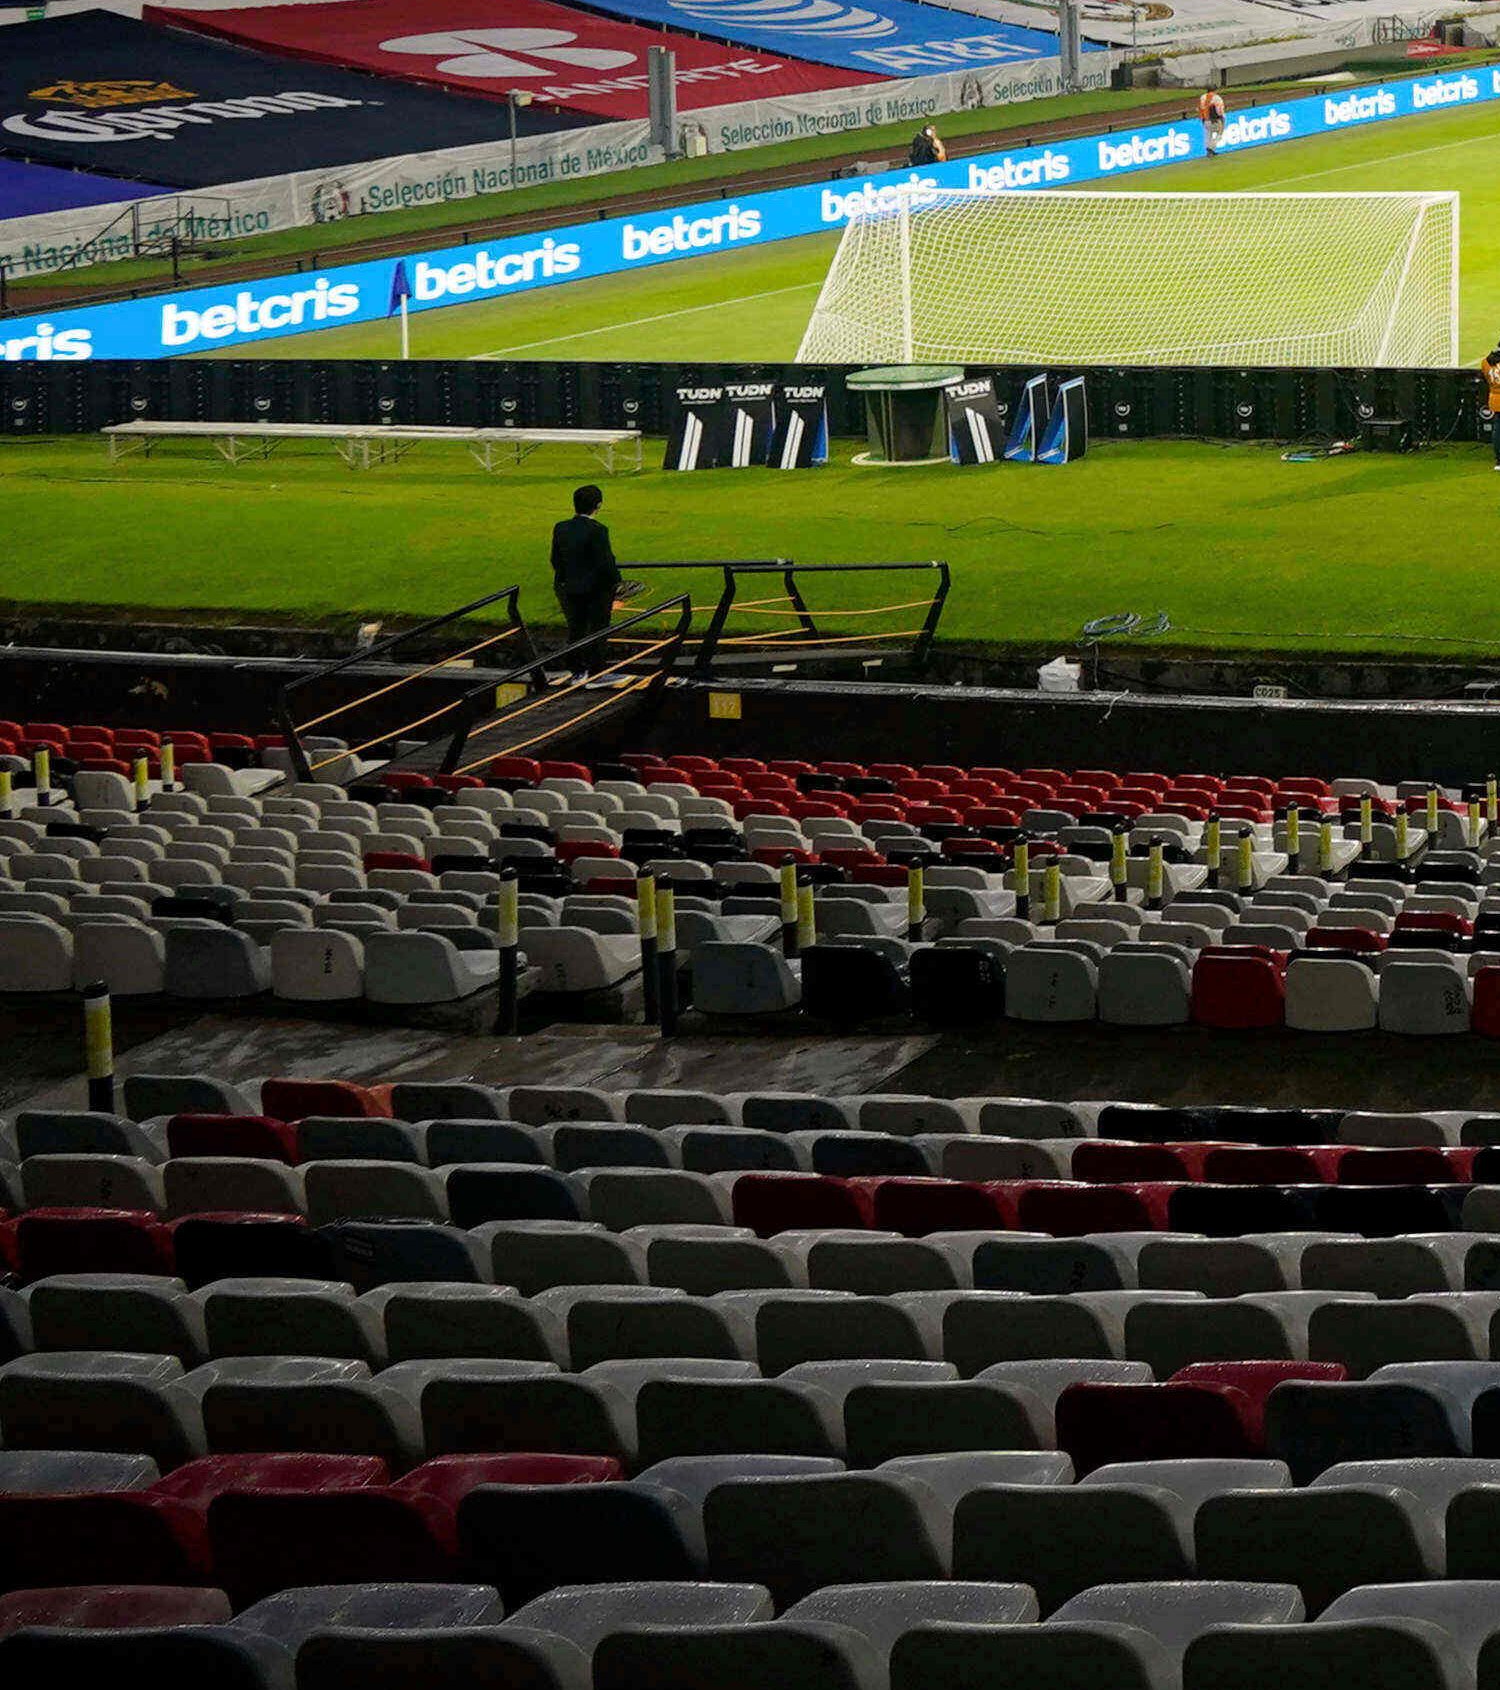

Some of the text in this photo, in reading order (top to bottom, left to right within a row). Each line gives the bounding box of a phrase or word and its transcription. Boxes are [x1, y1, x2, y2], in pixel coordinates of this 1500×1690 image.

[849, 33, 1043, 71] AT&T
[520, 57, 783, 103] ANRTE
[1056, 70, 1107, 91] Naonal
[1412, 74, 1479, 108] betcris
[2, 91, 364, 143] Corona
[720, 96, 936, 147] Selección Nacional de México
[1323, 87, 1396, 125] betcris
[967, 148, 1070, 191] betcris
[1098, 128, 1190, 170] betcris
[368, 139, 649, 210] Selección Nacional de México
[821, 173, 938, 222] betcris
[23, 232, 138, 273] Naciona
[622, 204, 762, 261] betcris
[414, 237, 580, 300] betcris
[161, 278, 359, 346] betcris
[676, 387, 723, 400] TUDN
[725, 384, 774, 397] TUDN
[783, 386, 825, 399] TUDN
[945, 380, 991, 398] TUDN
